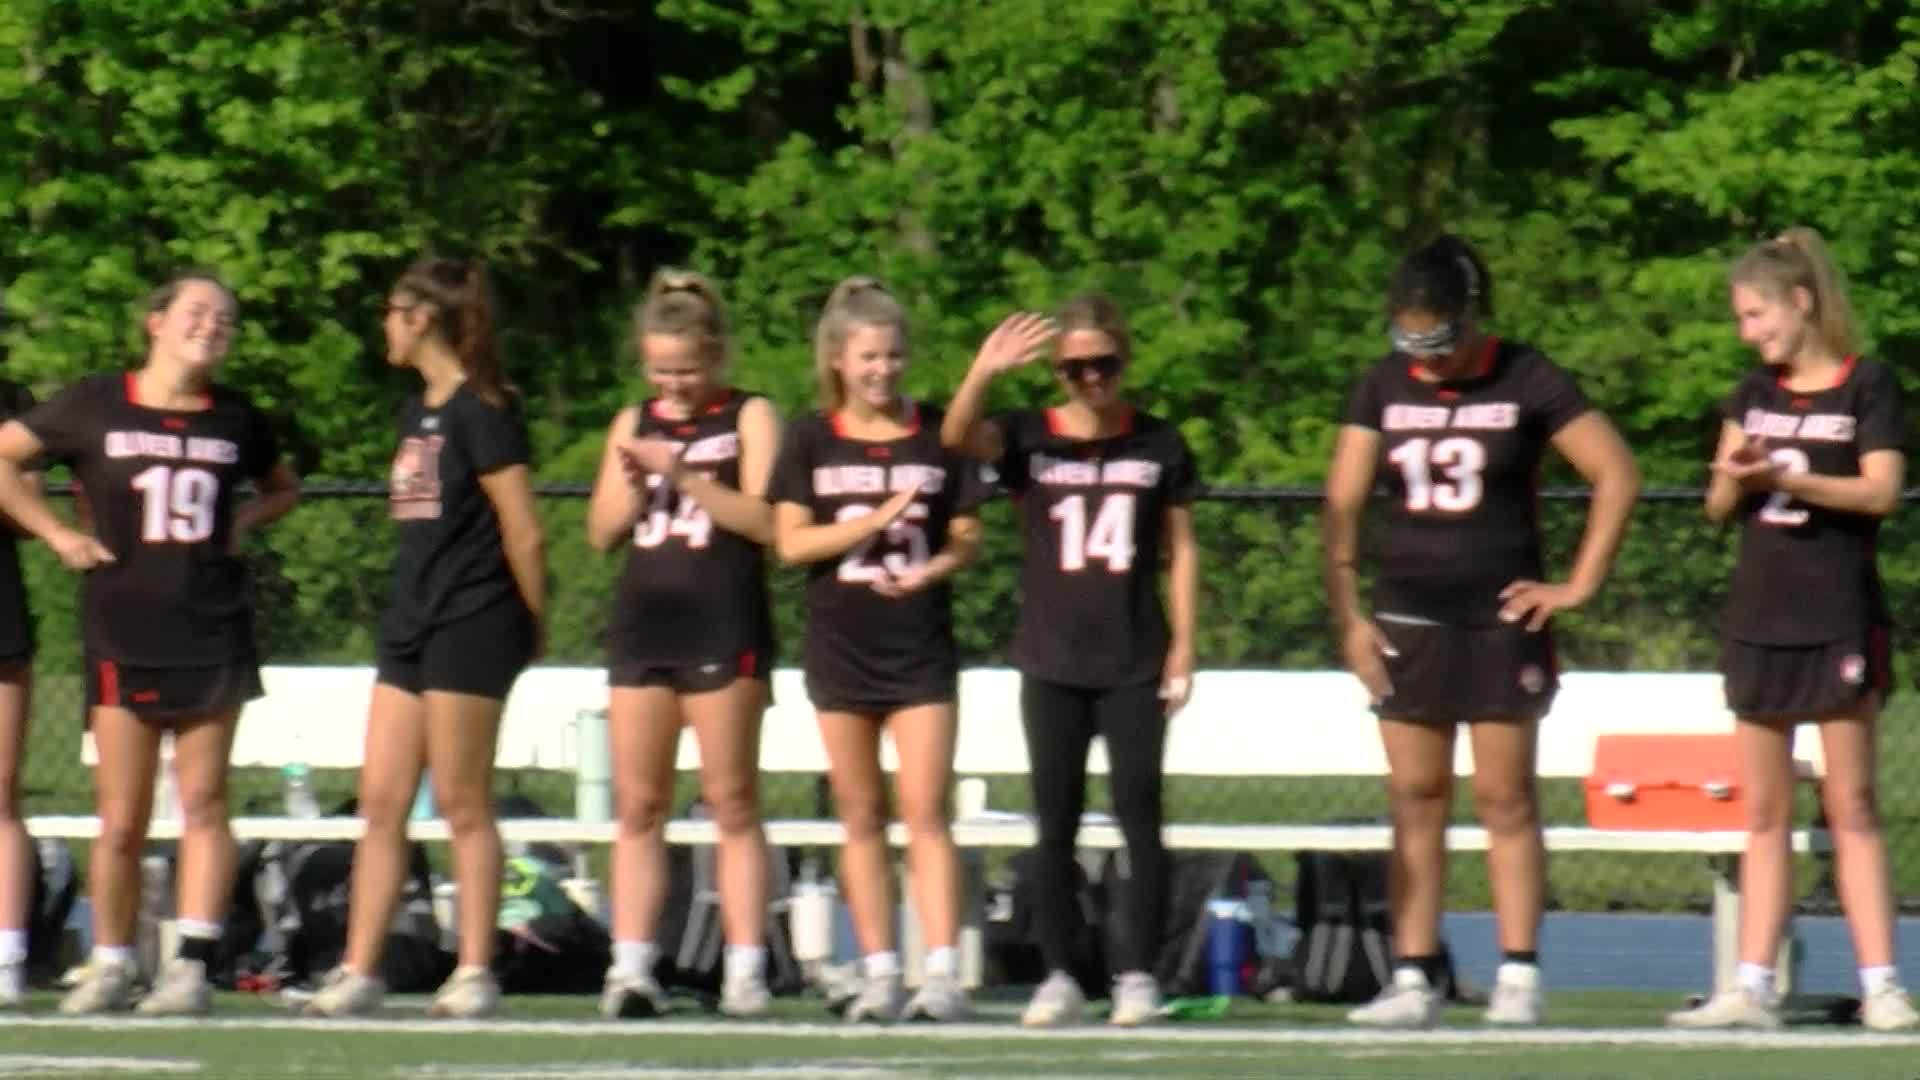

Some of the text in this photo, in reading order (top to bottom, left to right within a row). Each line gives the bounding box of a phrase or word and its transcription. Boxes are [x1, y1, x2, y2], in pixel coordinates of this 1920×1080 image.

[130, 465, 219, 544] 19
[1387, 436, 1488, 513] 13
[1759, 448, 1811, 525] 2
[1048, 494, 1137, 574] 14
